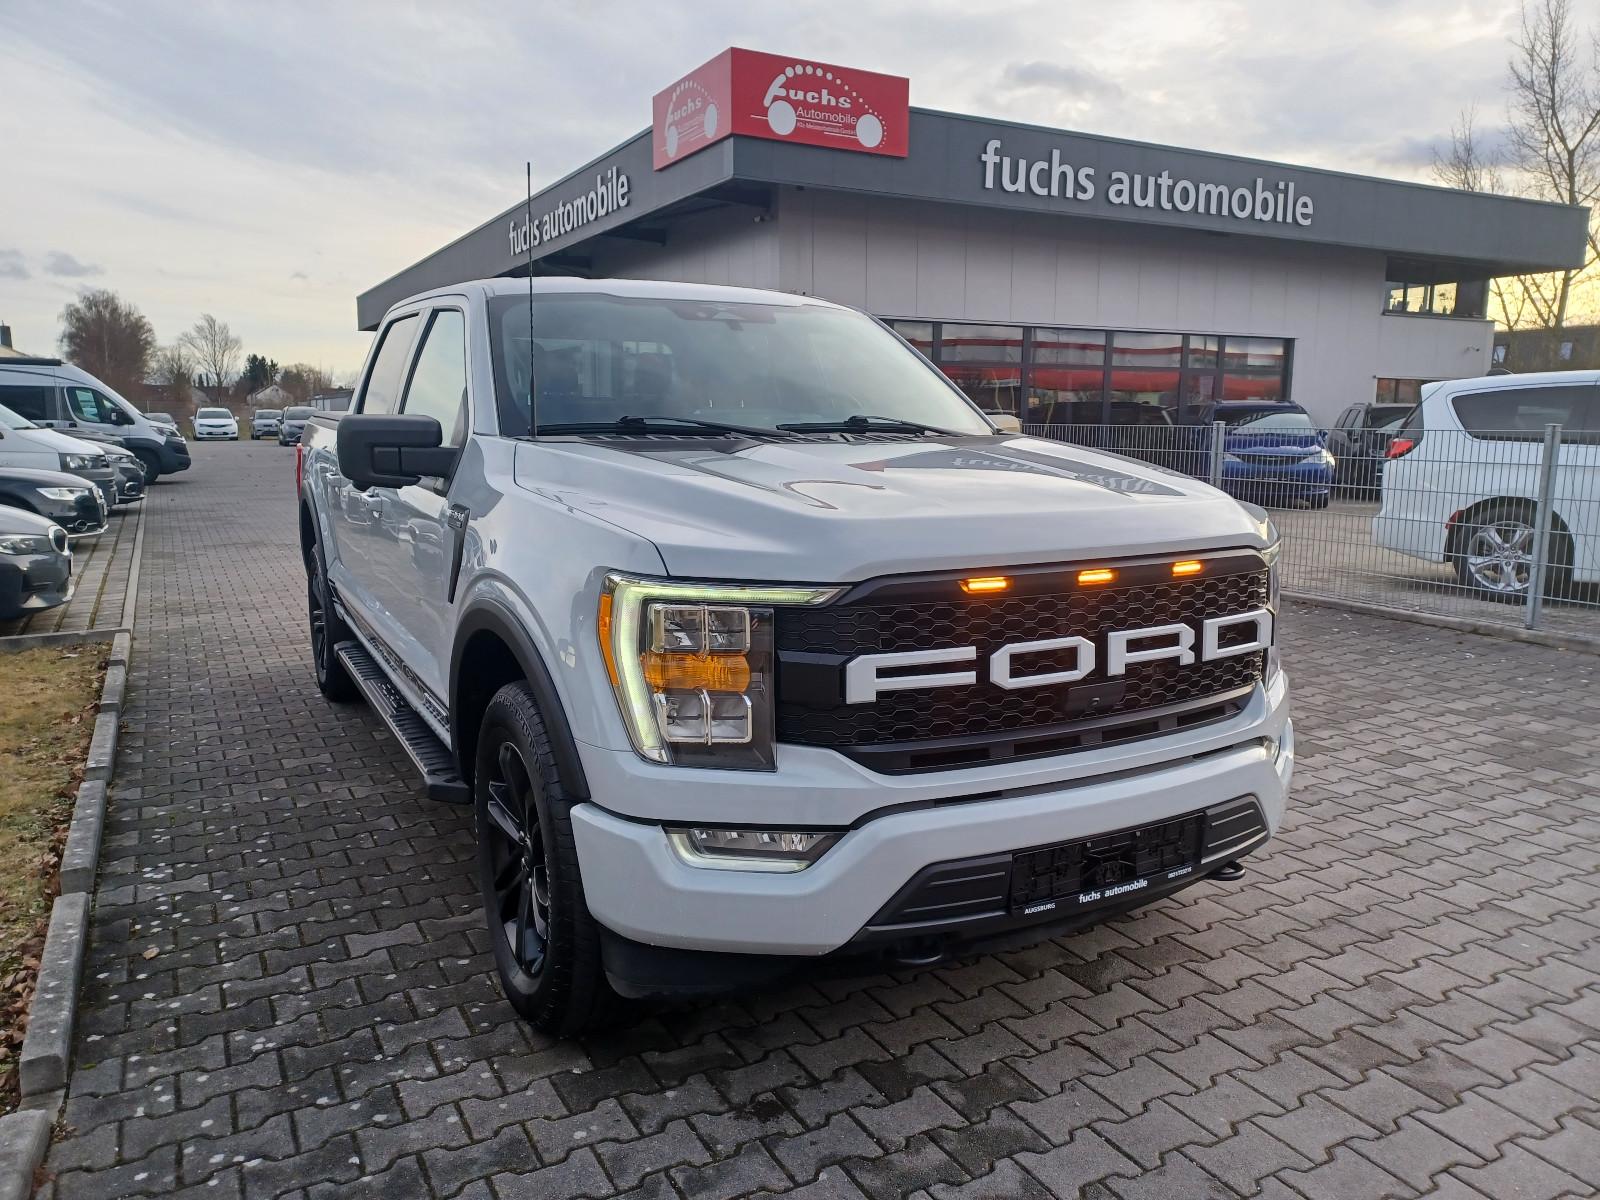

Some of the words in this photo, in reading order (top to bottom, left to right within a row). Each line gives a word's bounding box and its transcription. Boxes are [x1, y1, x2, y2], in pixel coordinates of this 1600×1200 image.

[796, 106, 857, 125] Automobile
[508, 213, 540, 257] fuchs
[542, 166, 629, 242] automobile
[980, 139, 1095, 201] fuchs
[1107, 169, 1314, 227] automobile
[846, 608, 1272, 705] FORD
[1024, 902, 1056, 915] AUGSBURG
[1079, 891, 1101, 903] fuchs
[1104, 879, 1148, 898] automobile
